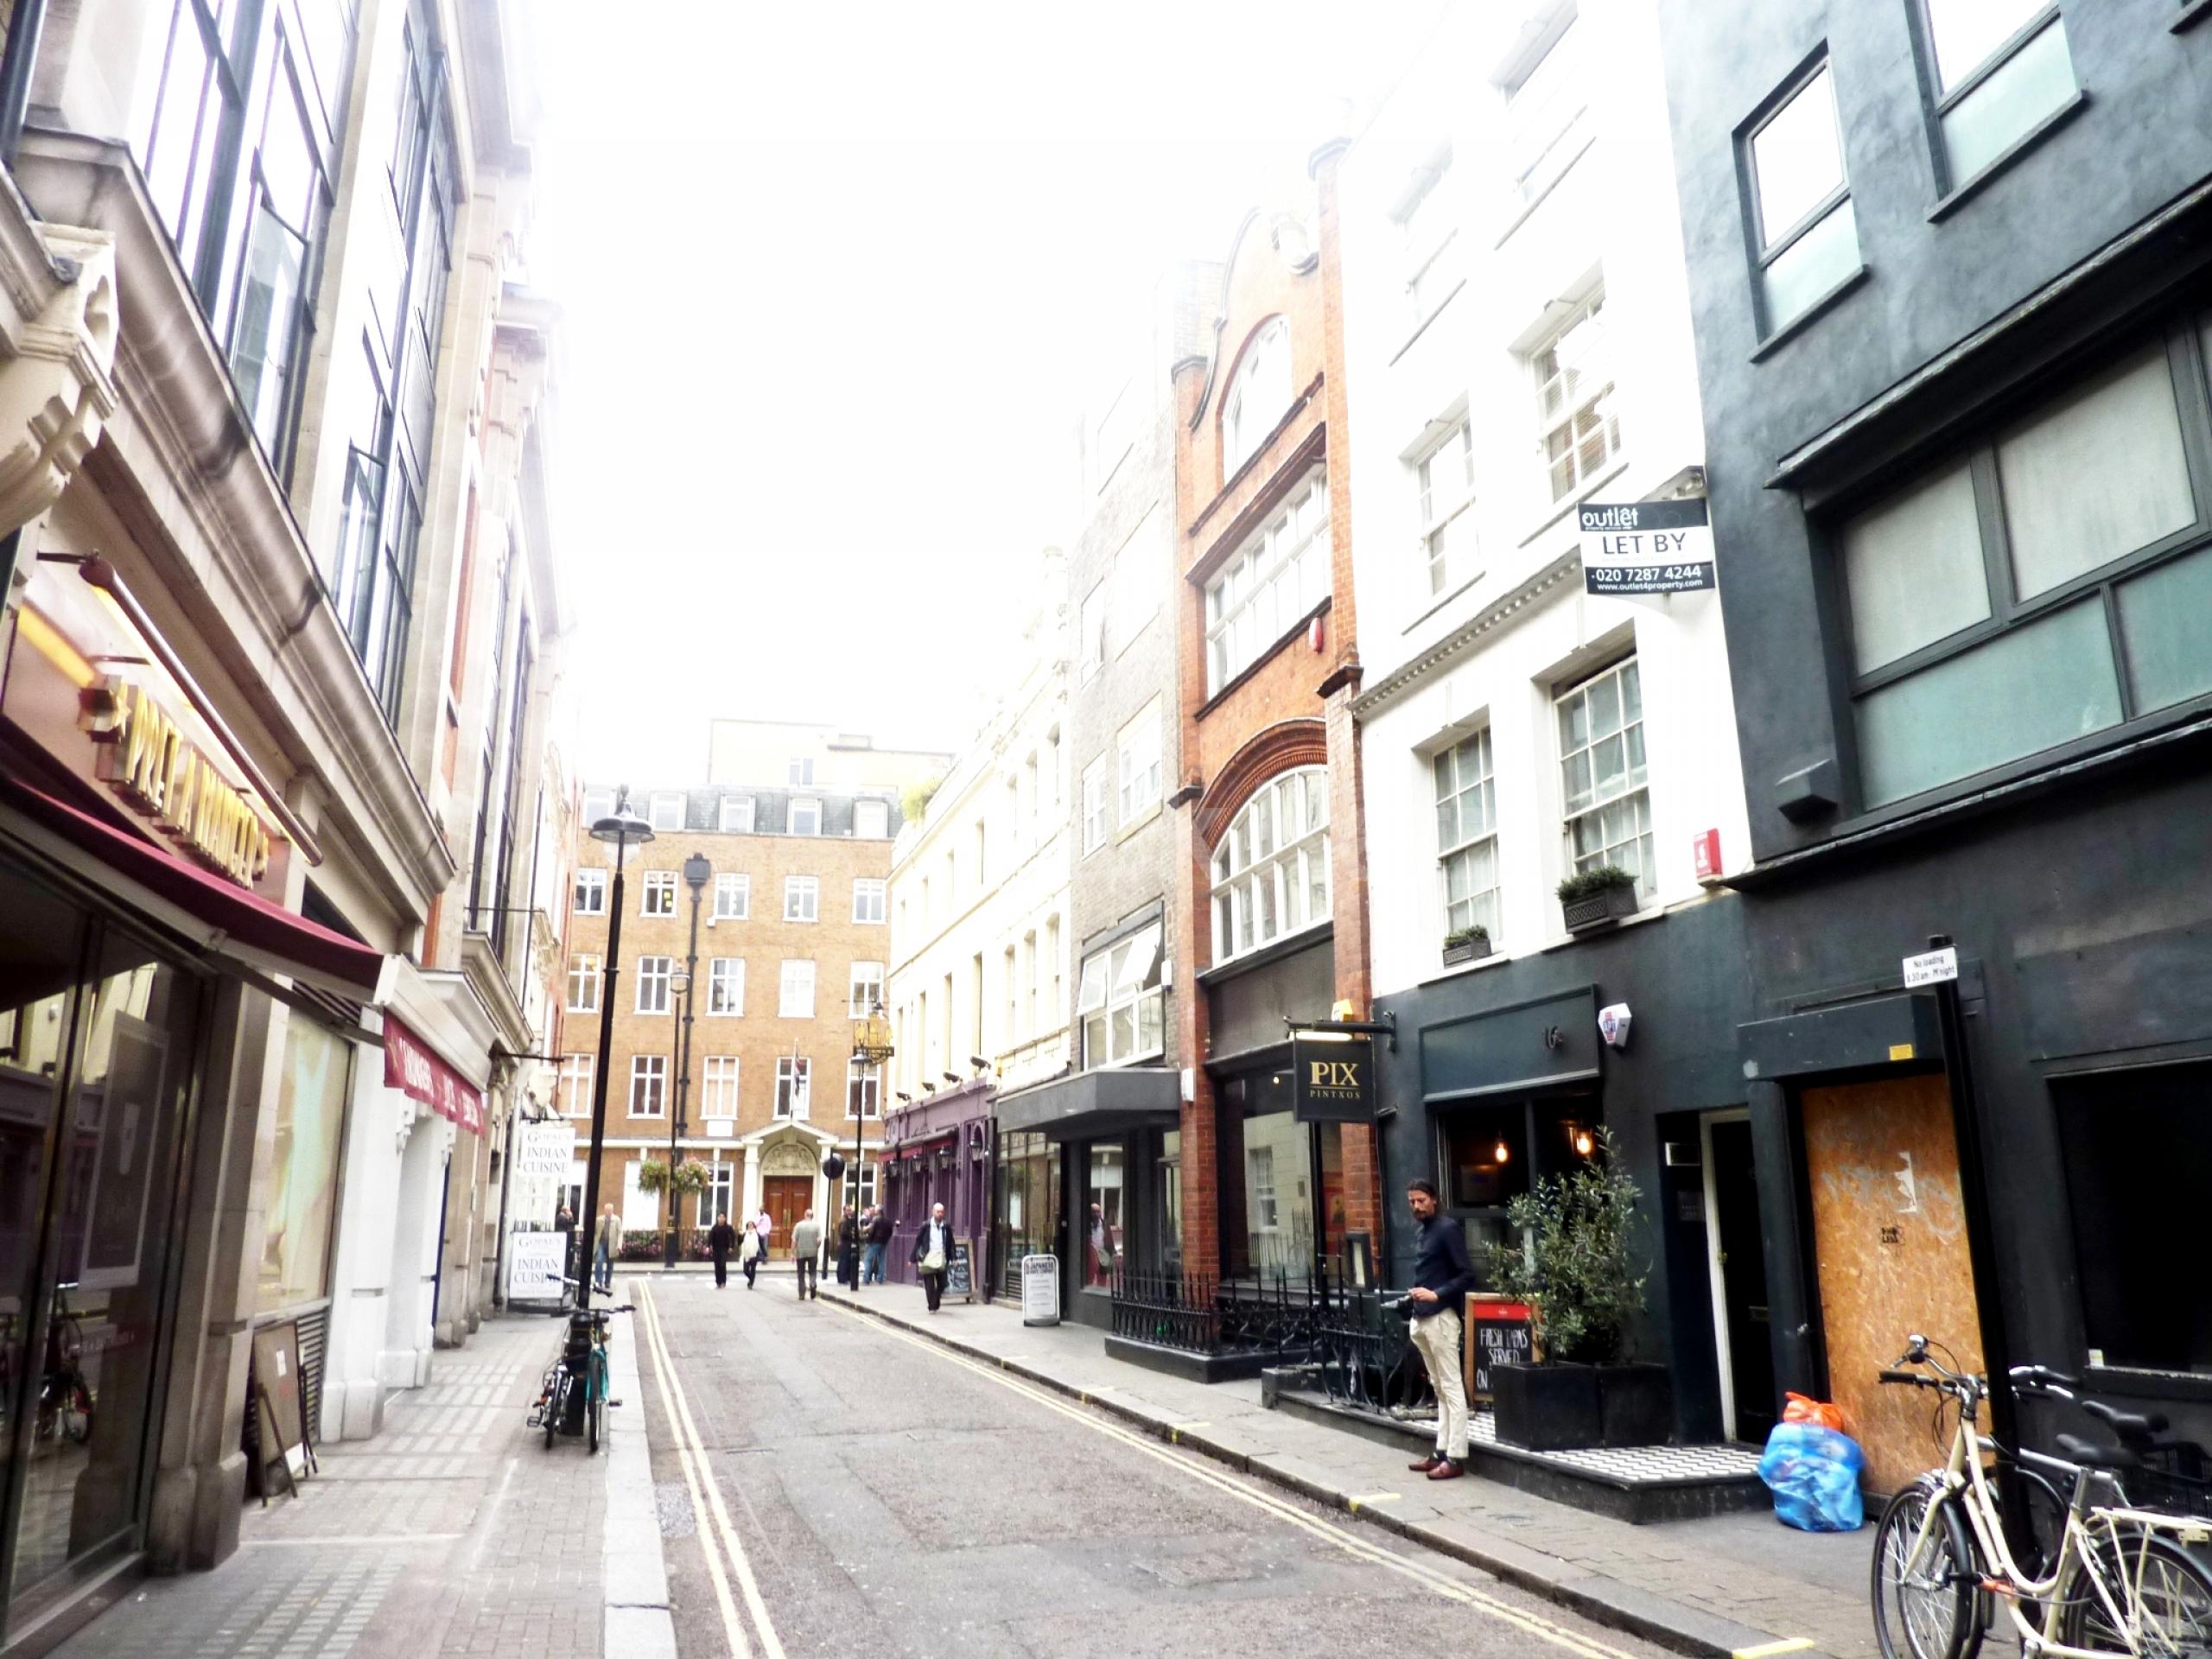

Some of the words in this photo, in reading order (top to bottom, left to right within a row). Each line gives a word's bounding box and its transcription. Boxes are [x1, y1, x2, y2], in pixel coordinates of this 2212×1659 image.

[1603, 536, 1643, 554] LET
[1654, 532, 1686, 552] BY
[1596, 569, 1622, 582] 020
[1625, 568, 1660, 581] 7287
[1664, 564, 1701, 578] 4244
[1598, 579, 1703, 591] www.outlet4property.com
[1309, 1061, 1360, 1086] PIX
[1310, 1089, 1361, 1100] PINTXOS
[527, 1147, 568, 1158] INDIAN
[523, 1161, 569, 1173] CUISINE
[518, 1258, 558, 1270] INDIAN
[1480, 1327, 1503, 1348] FRESH
[1488, 1347, 1521, 1367] SERVED
